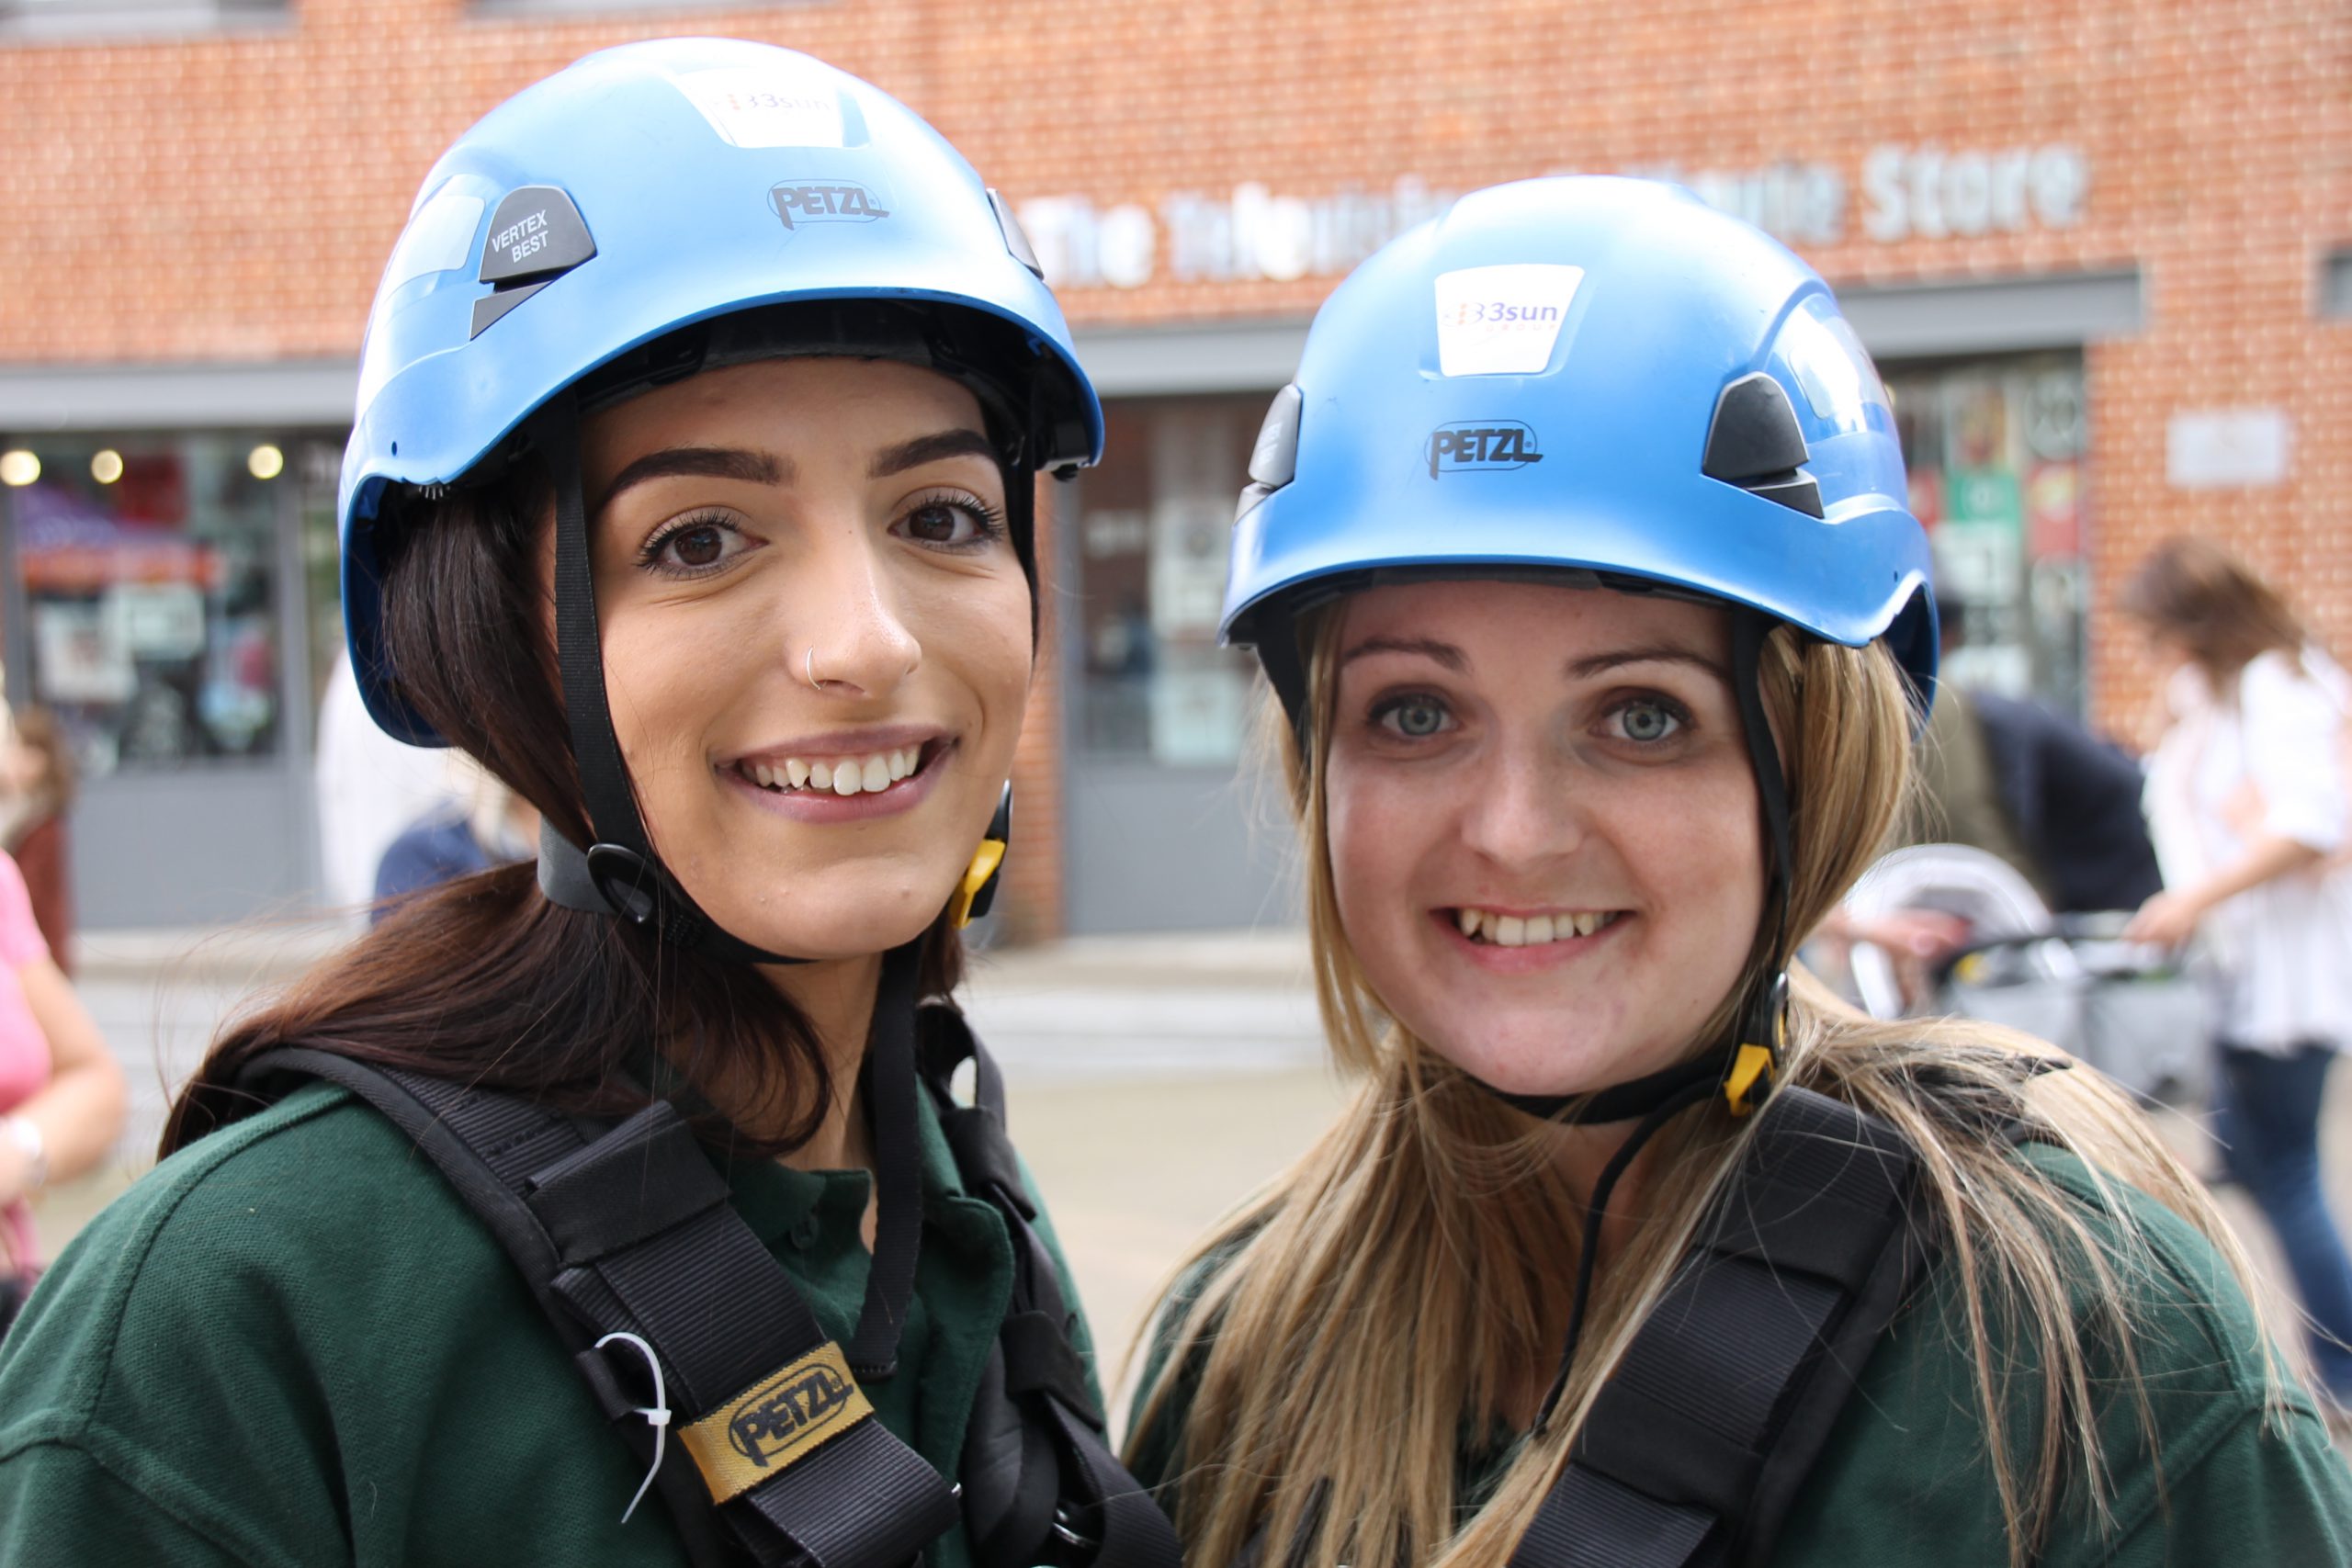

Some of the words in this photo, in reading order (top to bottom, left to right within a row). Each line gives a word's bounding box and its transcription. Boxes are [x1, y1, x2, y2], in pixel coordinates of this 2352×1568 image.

[771, 186, 890, 231] PETZL
[1860, 144, 2088, 243] Store
[492, 209, 548, 253] VERTEX
[511, 230, 548, 264] BEST
[1430, 428, 1544, 480] PETZL
[734, 1371, 854, 1467] PETZL
